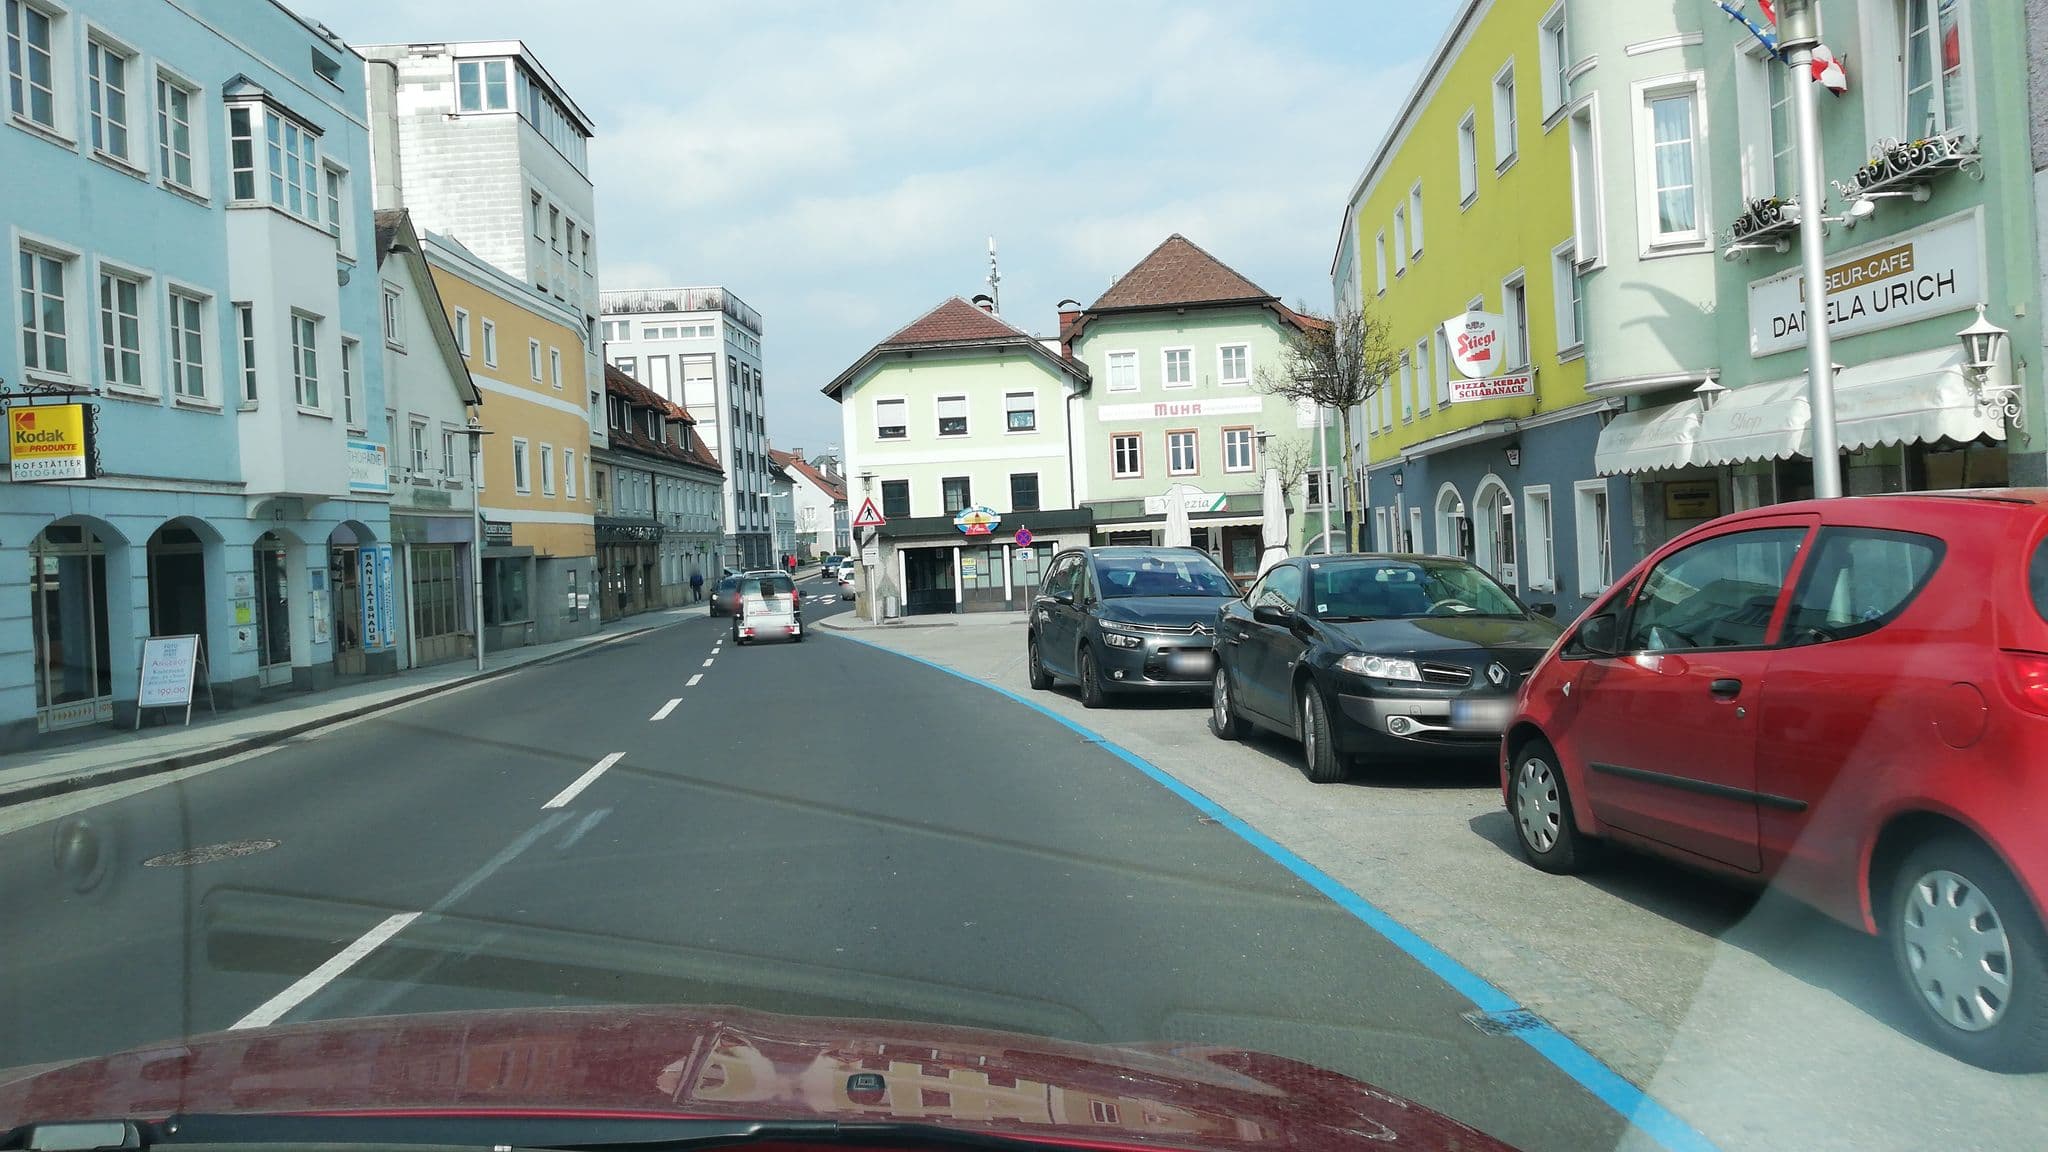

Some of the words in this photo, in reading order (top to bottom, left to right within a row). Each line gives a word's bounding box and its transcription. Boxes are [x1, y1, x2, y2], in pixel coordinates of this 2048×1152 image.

[1872, 269, 1955, 313] URICH
[1458, 330, 1496, 357] Stiegl
[1455, 382, 1487, 390] PIZZA
[1459, 385, 1525, 398] SCHABANACK
[1154, 403, 1202, 416] MUHR
[15, 430, 65, 444] Kodak
[29, 443, 78, 453] PRODUKTE
[364, 554, 376, 641] SANITÄTSHAUS
